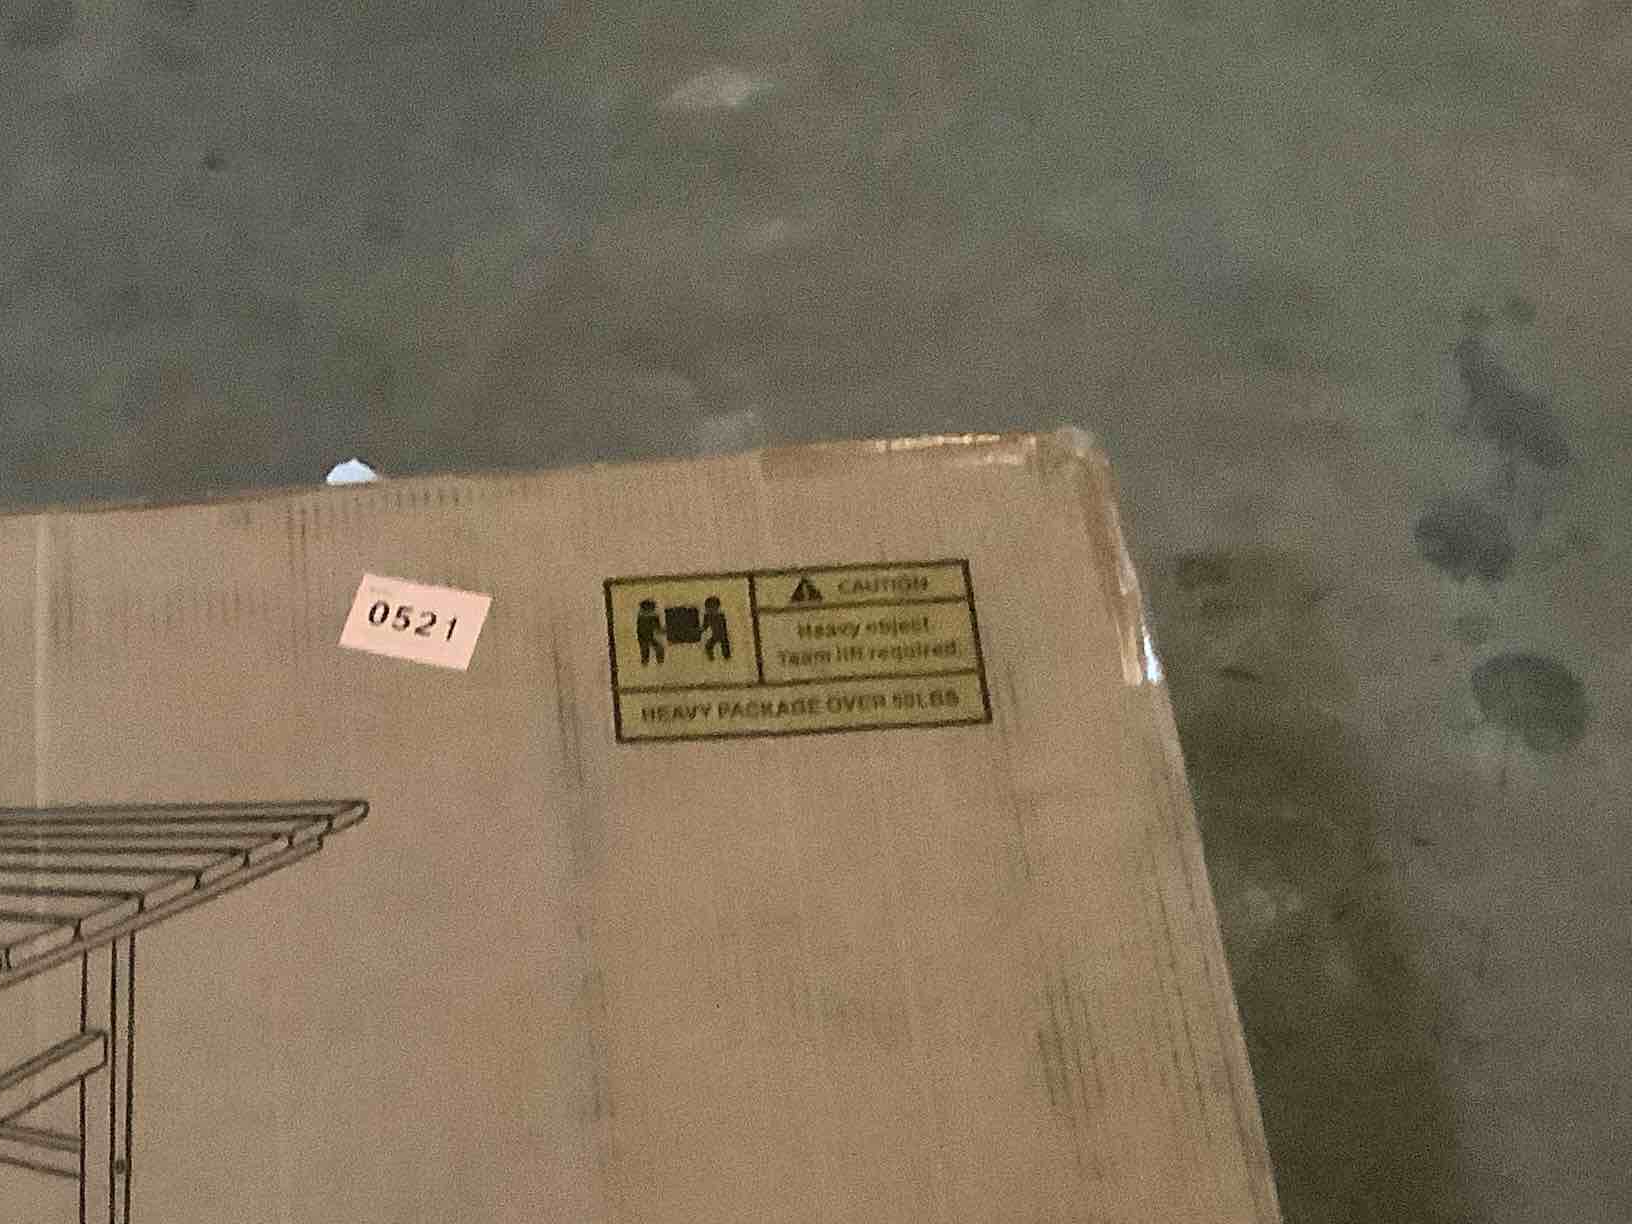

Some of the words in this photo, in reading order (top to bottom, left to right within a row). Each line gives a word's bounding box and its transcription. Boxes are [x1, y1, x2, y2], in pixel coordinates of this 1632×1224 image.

[838, 576, 929, 593] CAUTION
[368, 600, 458, 642] 0521
[798, 621, 860, 639] Heavy
[866, 616, 930, 637] object
[777, 649, 832, 666] Team
[641, 703, 711, 721] HEAVY
[718, 698, 817, 718] PACKAGE
[826, 694, 886, 713] OVER
